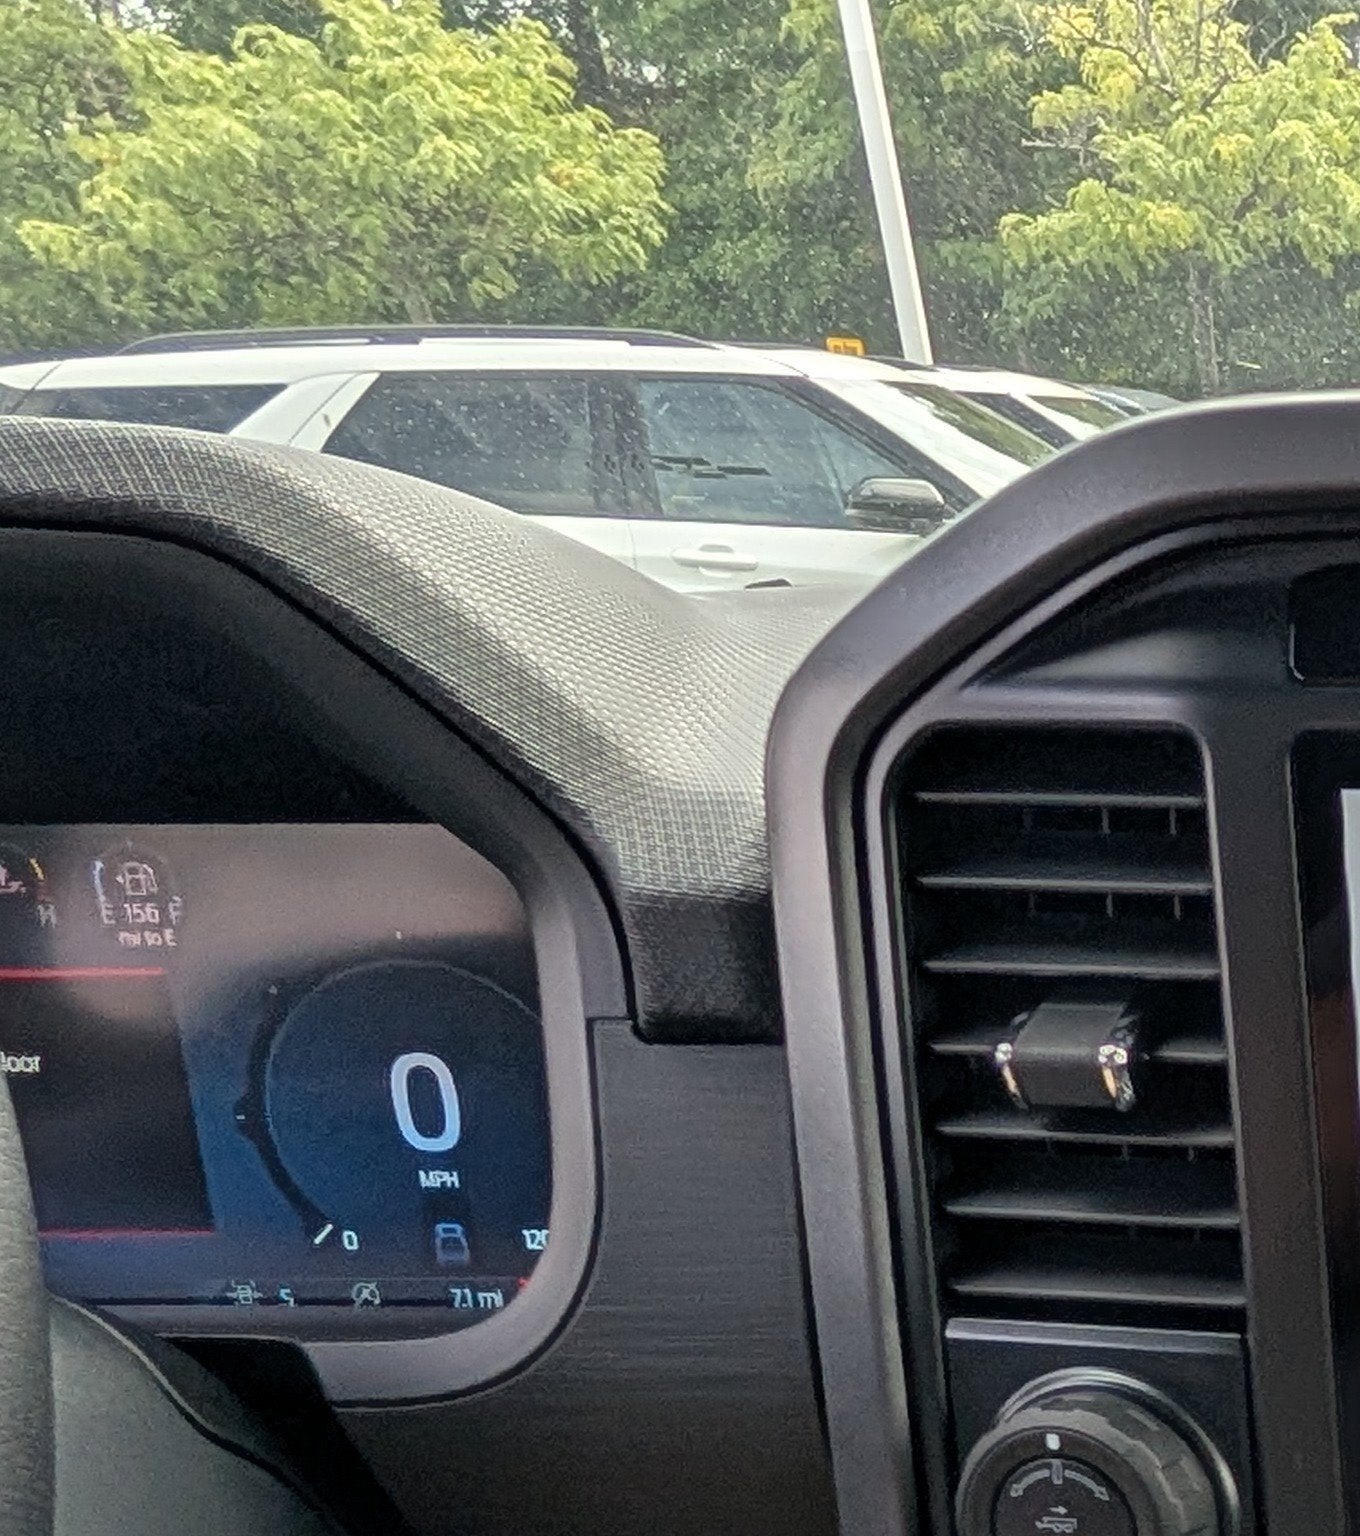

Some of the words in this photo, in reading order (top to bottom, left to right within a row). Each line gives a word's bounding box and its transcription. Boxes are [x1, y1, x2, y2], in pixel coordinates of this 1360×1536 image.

[124, 903, 160, 924] 156
[390, 1052, 461, 1152] 0
[418, 1170, 460, 1189] MPH
[342, 1230, 360, 1251] 0
